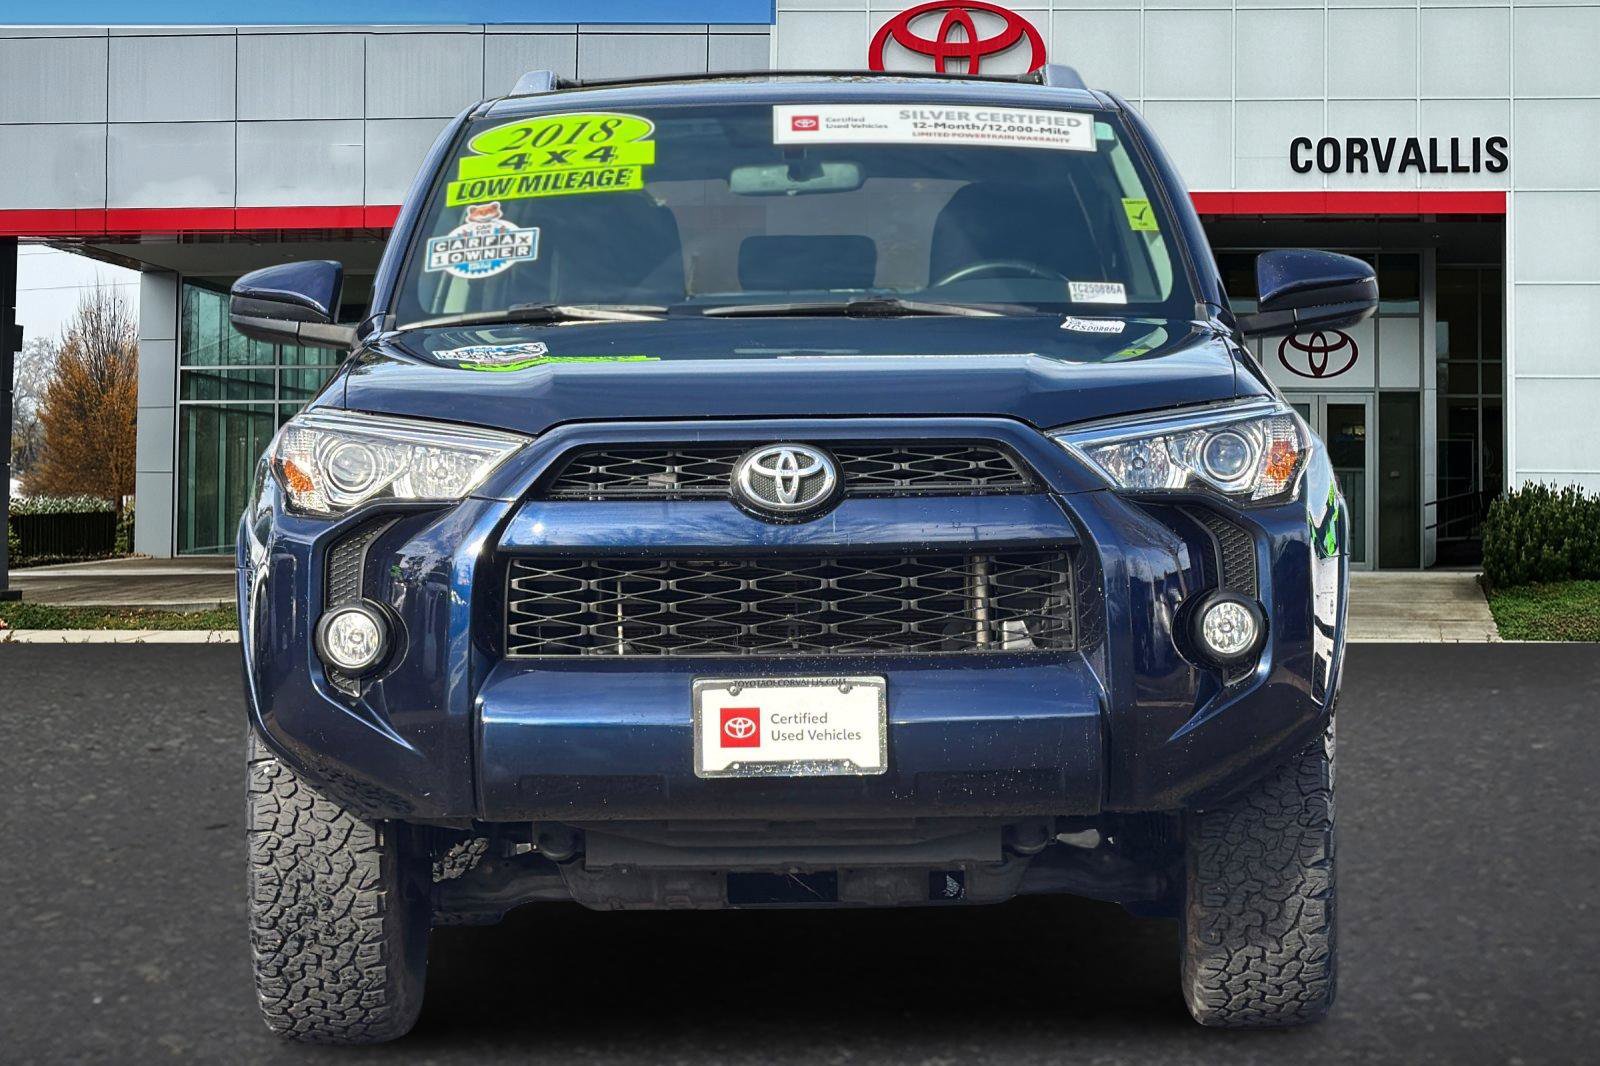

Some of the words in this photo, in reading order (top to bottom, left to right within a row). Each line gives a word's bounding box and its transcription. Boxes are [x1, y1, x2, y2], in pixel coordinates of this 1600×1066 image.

[899, 110, 968, 122] SILVER
[974, 112, 1082, 128] CERTIFIED
[498, 118, 623, 151] 2018
[912, 121, 1071, 136] 12-Month/12,000-Mile
[950, 132, 1015, 141] POWERTRAIN
[1015, 134, 1071, 144] WARRANTY
[1290, 136, 1509, 173] CORVALLIS
[456, 176, 516, 201] LOW
[517, 168, 633, 194] MILEAGE
[435, 233, 531, 253] CARFAX
[770, 712, 828, 725] Certified
[771, 729, 804, 741] Used
[808, 728, 862, 741] Vehicles
